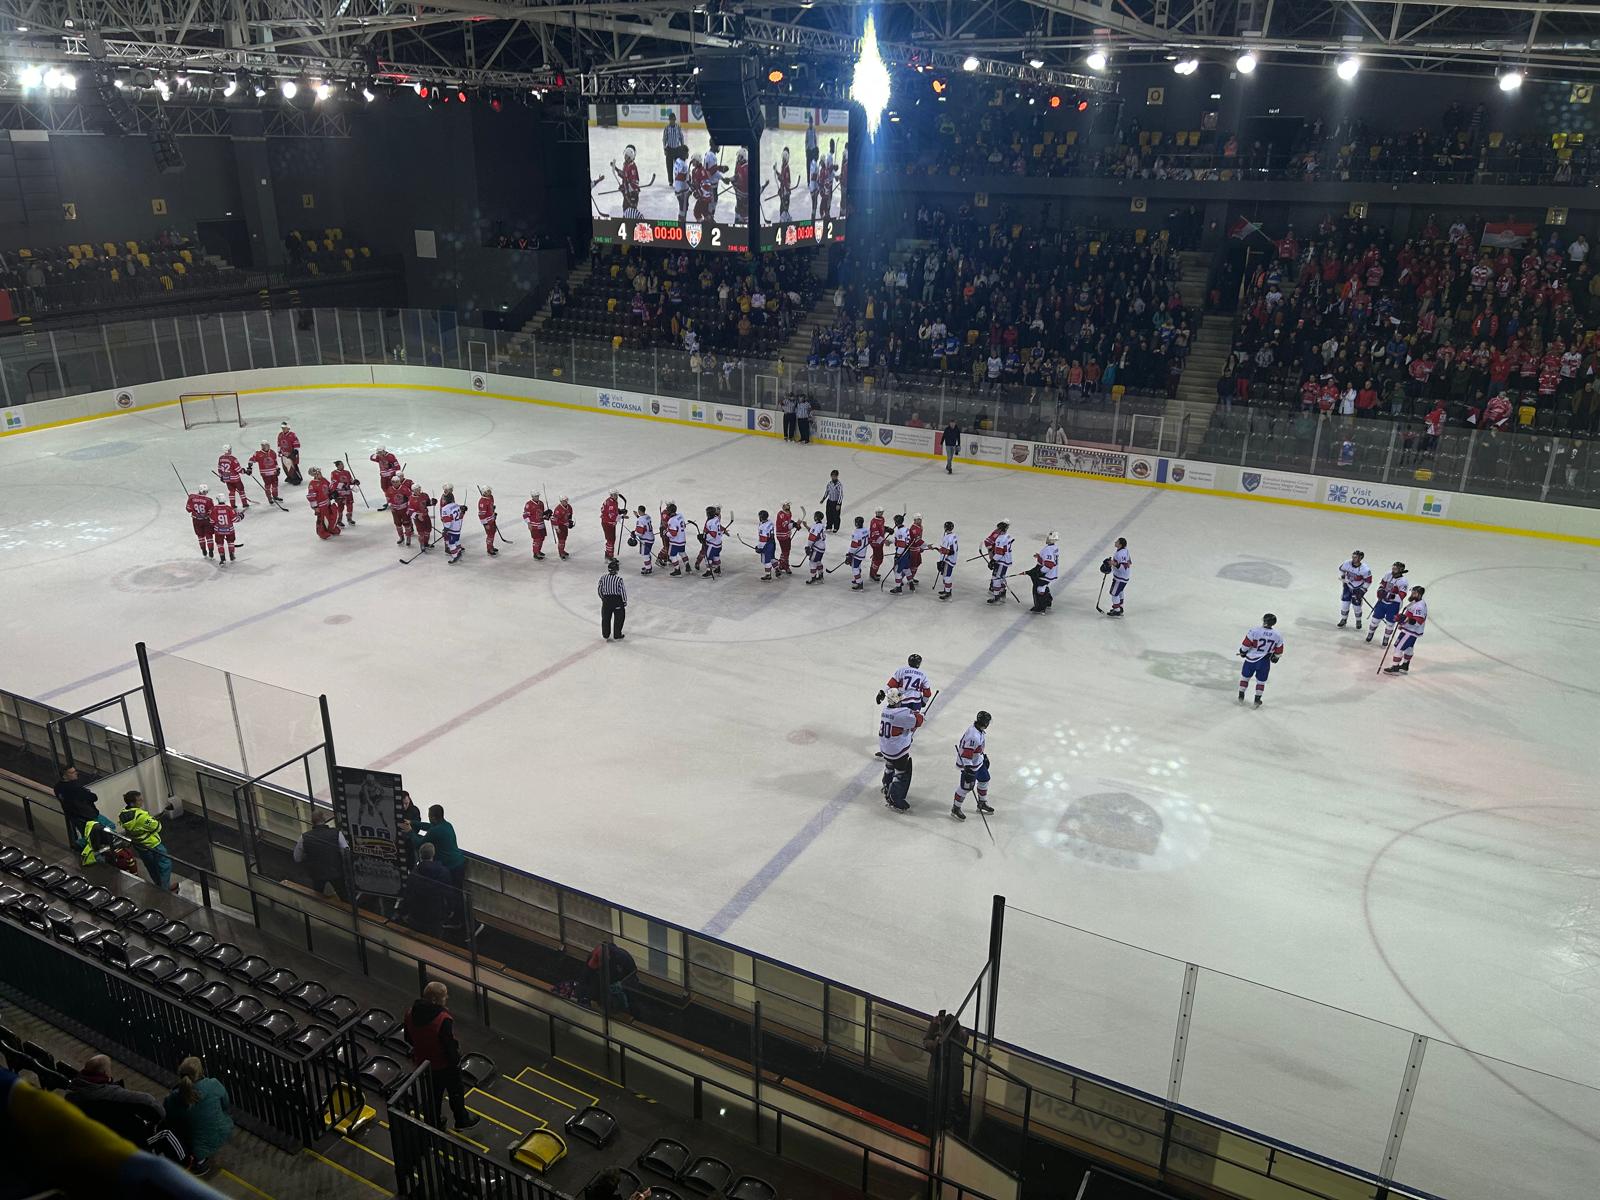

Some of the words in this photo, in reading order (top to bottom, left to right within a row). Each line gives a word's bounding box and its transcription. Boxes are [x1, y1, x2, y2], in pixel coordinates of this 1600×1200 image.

[617, 222, 627, 240] 4
[654, 226, 682, 240] 00:00
[711, 227, 721, 246] 2
[775, 227, 782, 245] 4
[827, 222, 833, 239] 2
[611, 401, 642, 412] COVASNA
[1352, 487, 1372, 496] Visit
[1350, 496, 1404, 511] COVASNA
[218, 514, 229, 525] 91
[1257, 638, 1275, 652] 27
[904, 676, 921, 692] 74
[879, 720, 892, 738] 30
